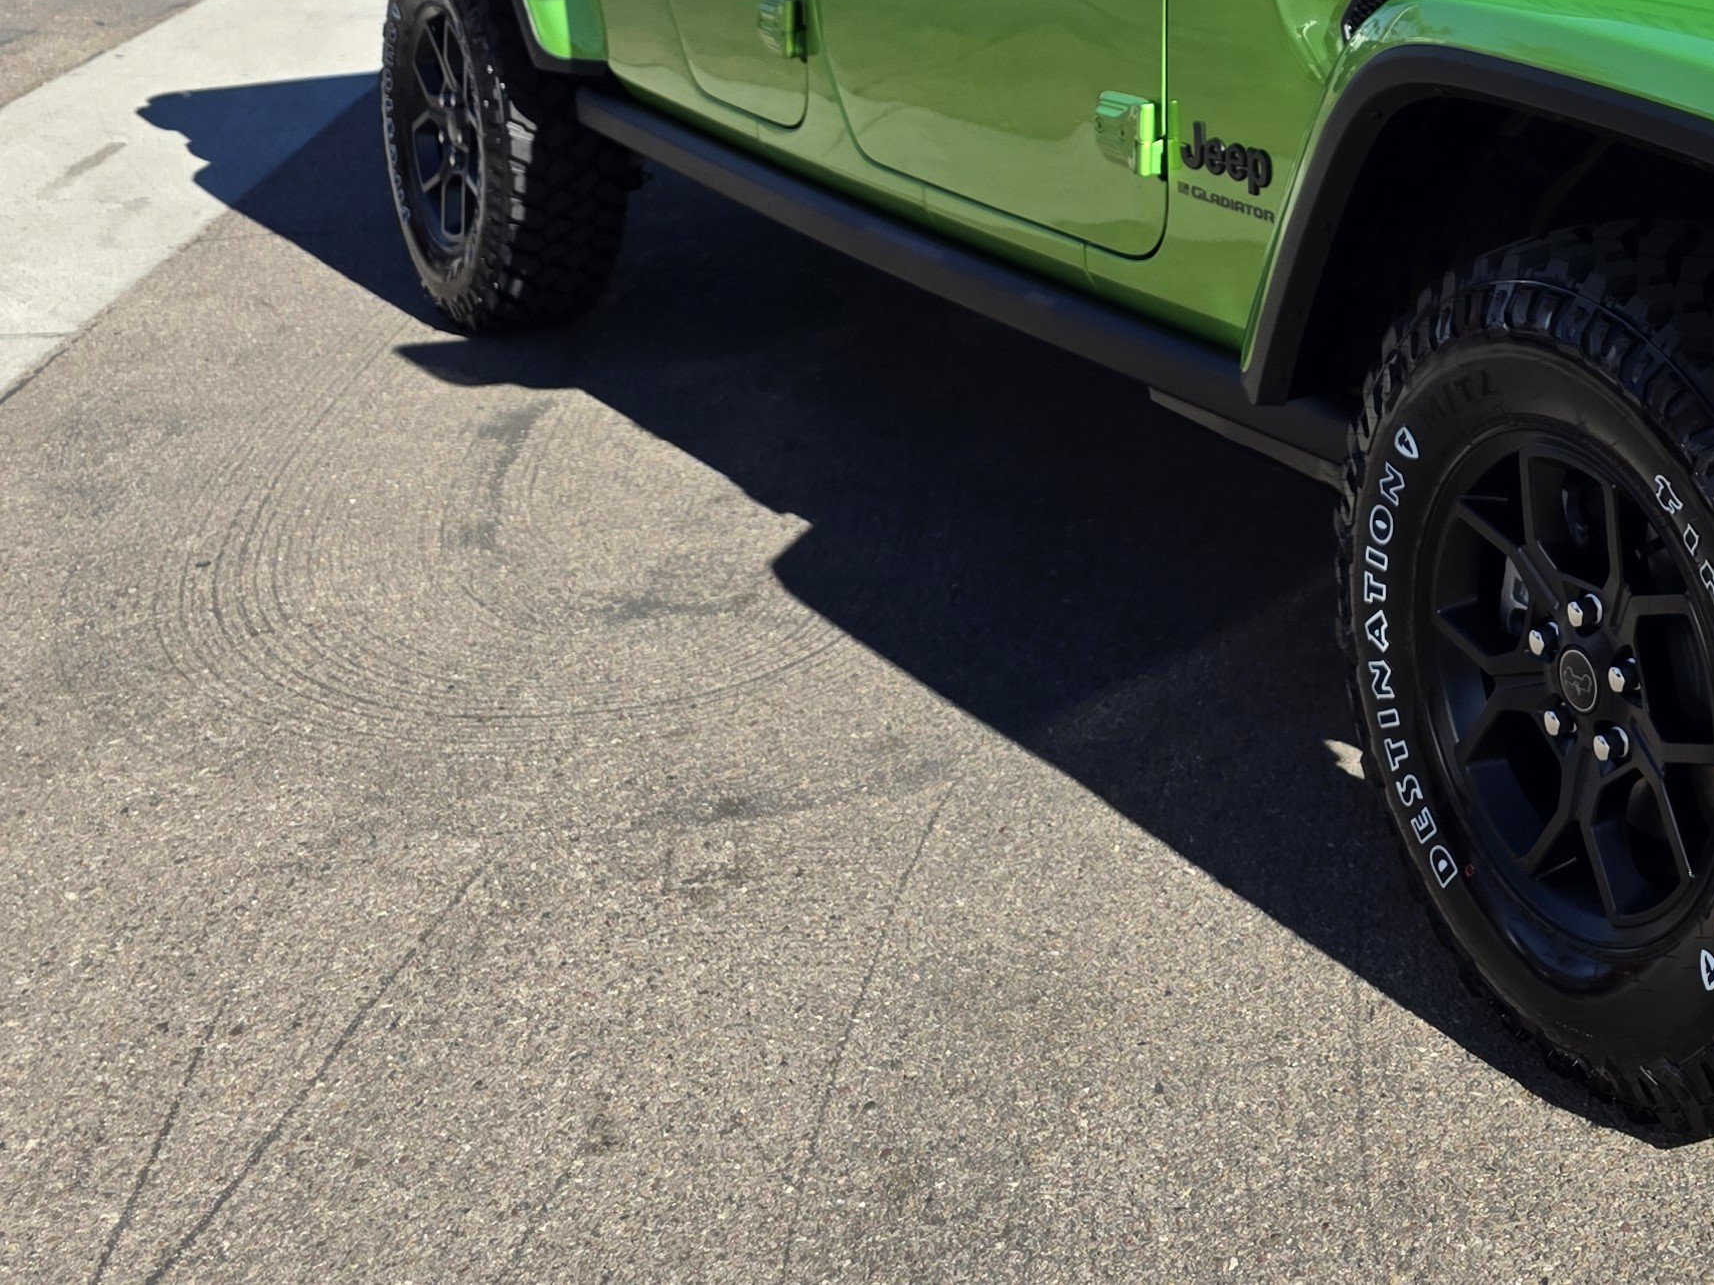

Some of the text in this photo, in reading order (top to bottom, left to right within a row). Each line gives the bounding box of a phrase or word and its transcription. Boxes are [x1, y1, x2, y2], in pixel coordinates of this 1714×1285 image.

[1180, 121, 1272, 196] Jeep
[1191, 185, 1275, 224] GLADIATOR
[1364, 462, 1459, 889] DESTINATION
